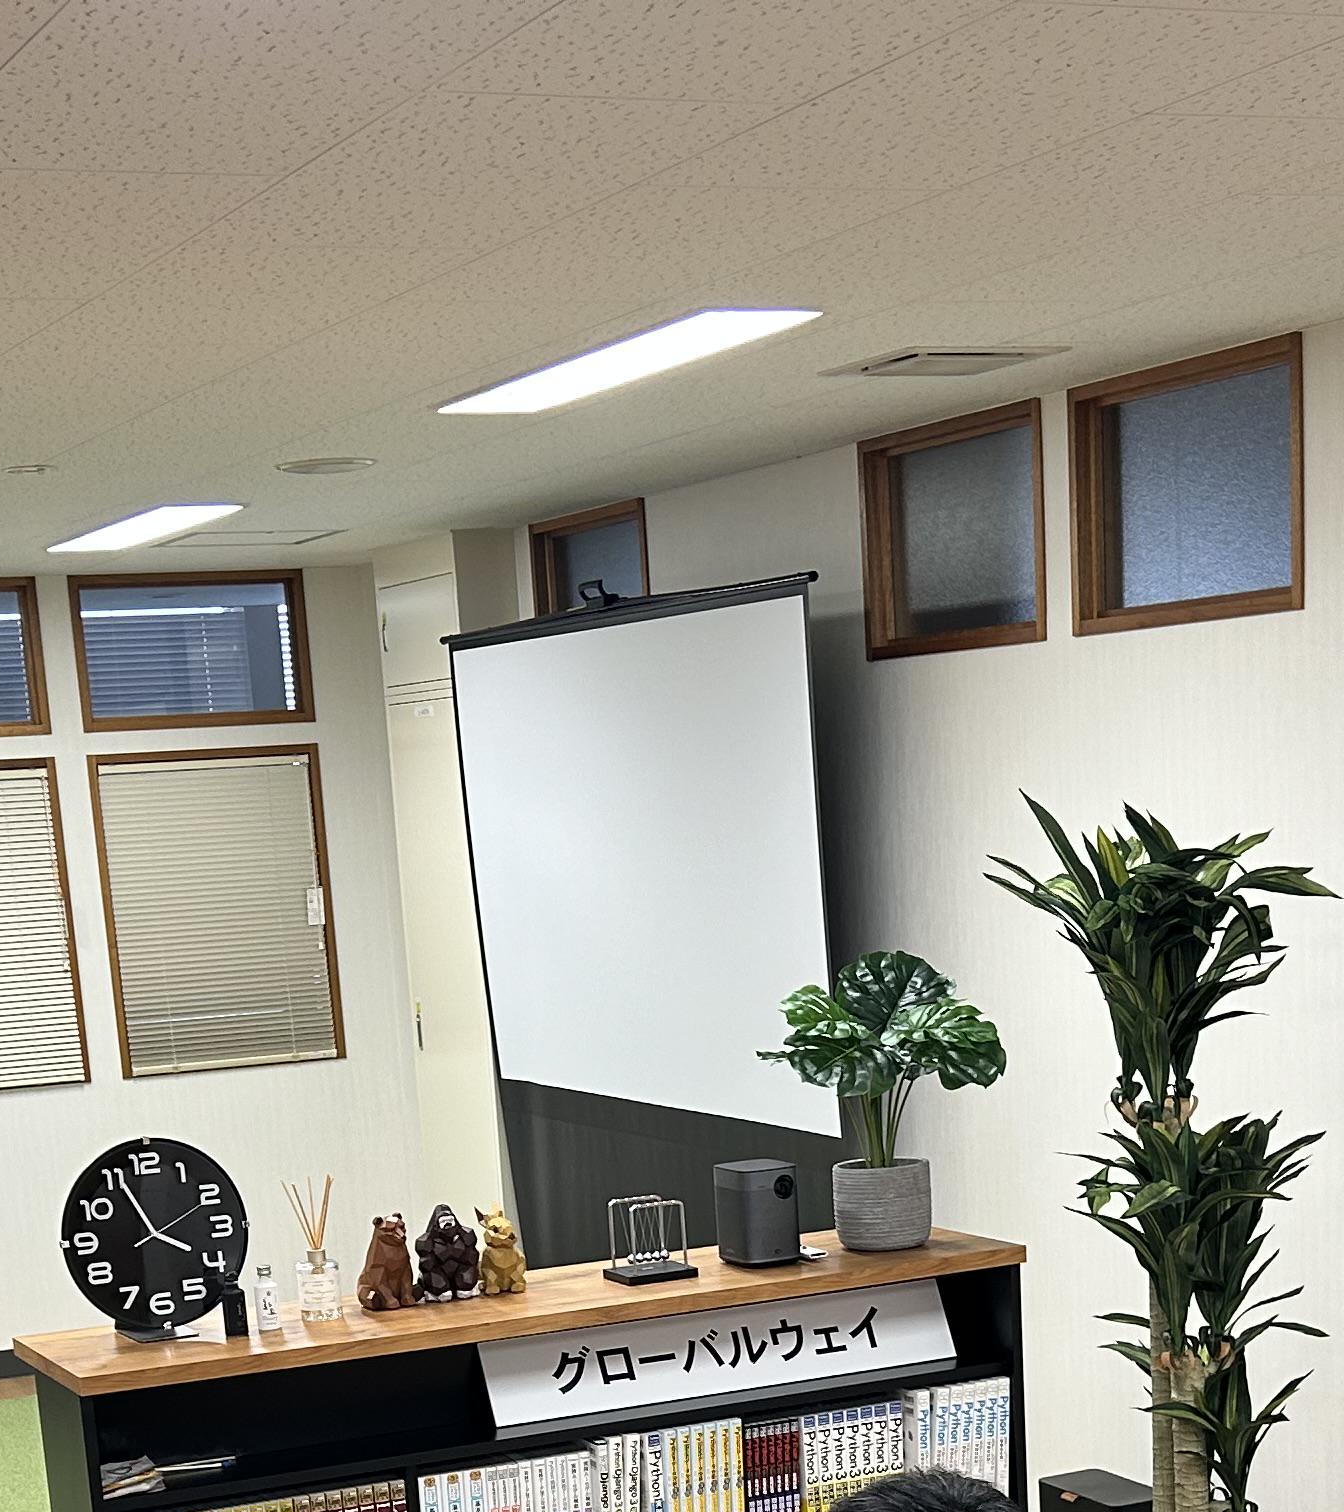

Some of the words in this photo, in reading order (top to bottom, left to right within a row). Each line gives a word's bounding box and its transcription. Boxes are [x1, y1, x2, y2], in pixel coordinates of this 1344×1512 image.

[128, 1152, 161, 1175] 12
[175, 1161, 187, 1183] 1
[102, 1168, 125, 1190] 11
[198, 1183, 221, 1206] 2
[79, 1197, 114, 1221] 10
[209, 1214, 234, 1239] 3
[73, 1232, 99, 1255] 9
[87, 1262, 114, 1285] 8
[202, 1250, 226, 1273] 4
[119, 1285, 140, 1310] 7
[182, 1278, 207, 1301] 5
[149, 1292, 175, 1316] 6
[552, 1305, 881, 1394] グローバルウェイ
[936, 1407, 948, 1445] Python
[950, 1404, 961, 1443] Python
[961, 1402, 973, 1441] Python
[974, 1400, 985, 1439] Python
[986, 1398, 997, 1437] Python
[997, 1396, 1008, 1435] Python
[874, 1420, 887, 1464] Python
[889, 1418, 902, 1461] Python
[919, 1410, 930, 1449] Python
[630, 1440, 638, 1466] Python
[804, 1431, 817, 1475] Python
[819, 1429, 831, 1473] Python
[833, 1426, 845, 1470] Python
[847, 1424, 859, 1468] Python
[861, 1422, 873, 1466] Python
[649, 1451, 662, 1498] Python
[822, 1474, 833, 1482] 3
[836, 1471, 847, 1480] 3
[850, 1469, 861, 1478] 3
[863, 1466, 874, 1475] 3
[877, 1464, 888, 1473] 3
[891, 1461, 903, 1471] 3
[600, 1472, 608, 1509] Django
[613, 1469, 622, 1500] Django
[629, 1466, 638, 1498] Django
[807, 1476, 818, 1484] 3
